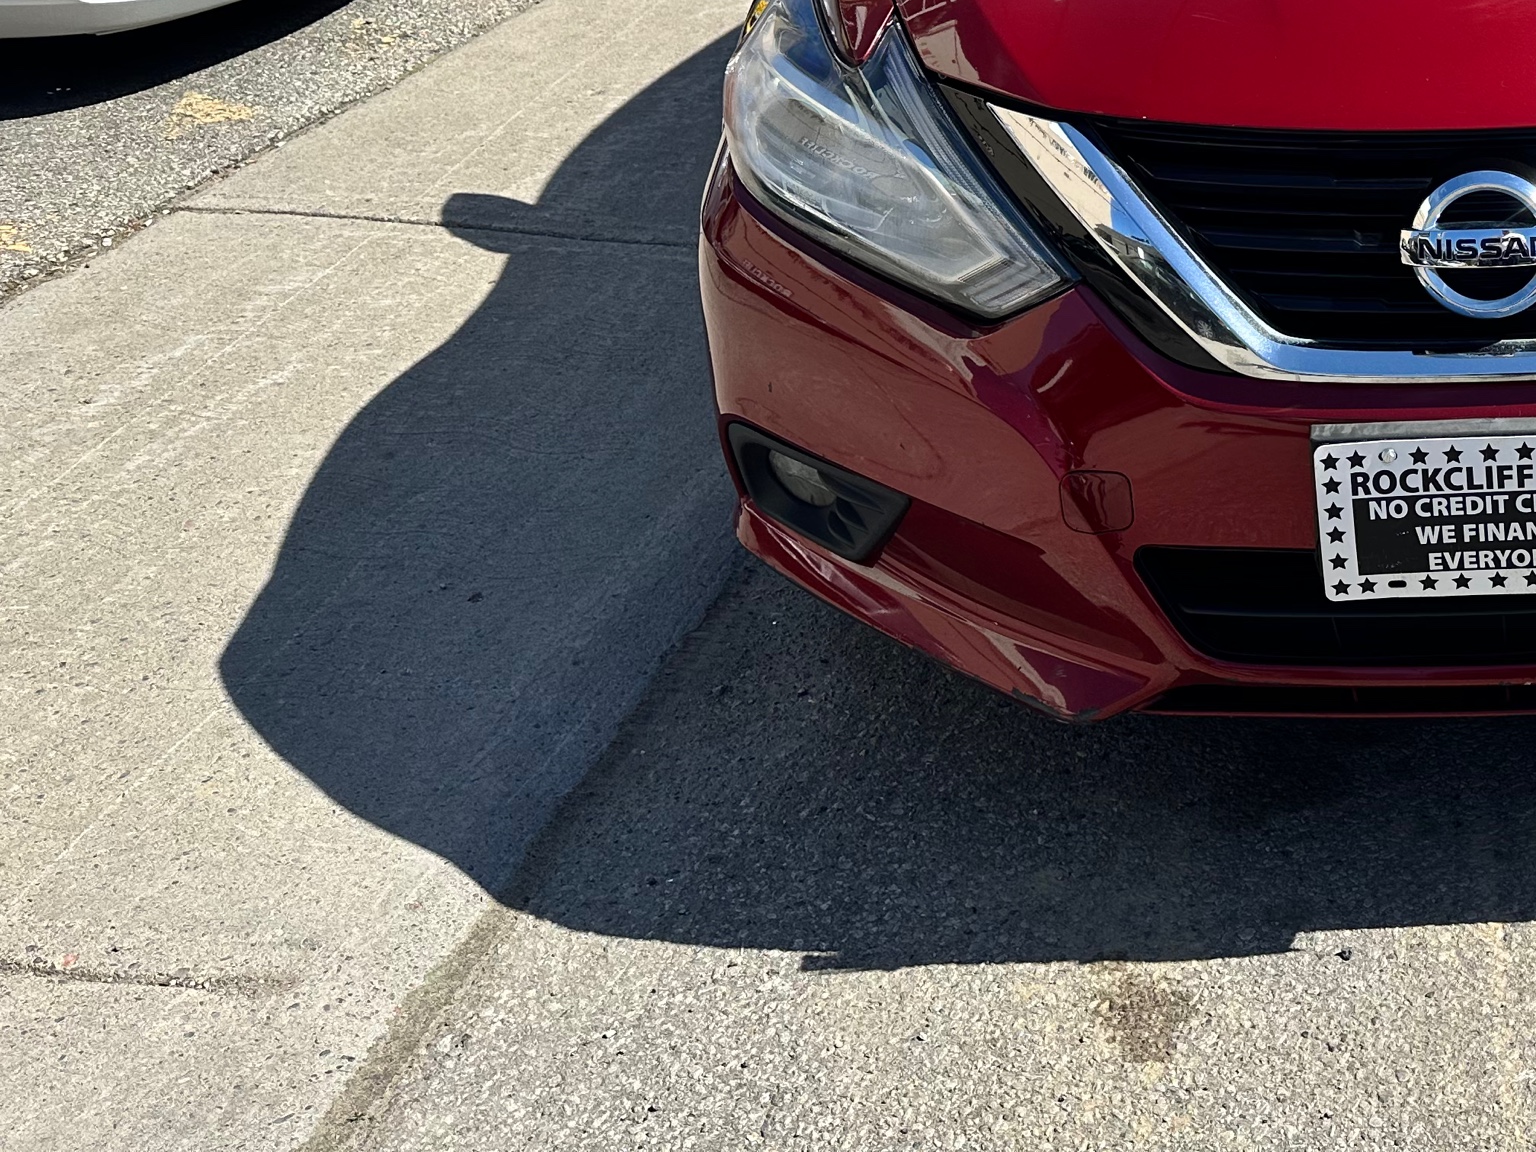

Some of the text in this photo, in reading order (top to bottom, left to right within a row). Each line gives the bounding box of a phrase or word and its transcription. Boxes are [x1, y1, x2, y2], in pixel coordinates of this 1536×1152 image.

[1350, 463, 1534, 497] ROCKCLIFF
[1368, 499, 1409, 521] NO
[1414, 494, 1509, 517] CREDIT
[1415, 524, 1456, 545] WE
